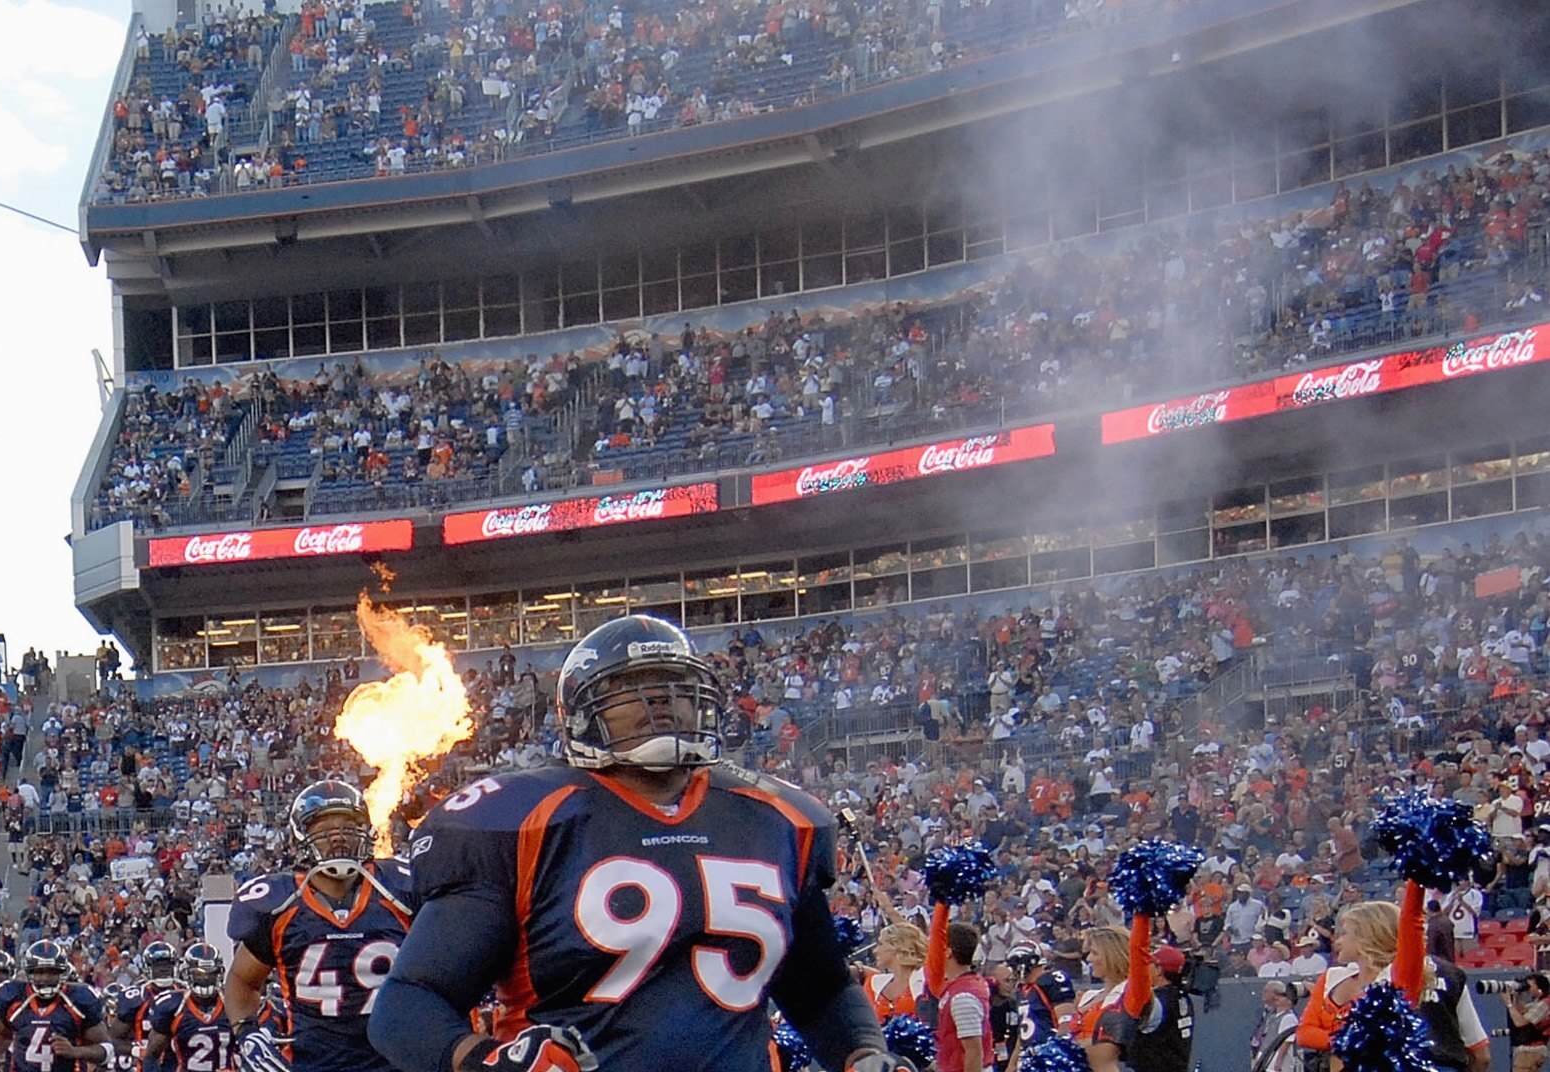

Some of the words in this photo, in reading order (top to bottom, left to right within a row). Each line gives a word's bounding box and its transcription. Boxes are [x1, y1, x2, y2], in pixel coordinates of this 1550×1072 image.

[184, 533, 252, 563] Coca-Cola
[294, 524, 364, 554] Coca-Cola
[1034, 785, 1044, 799] 7
[640, 834, 709, 847] BRONCOS
[1451, 902, 1465, 921] 6
[574, 855, 789, 1013] 95
[295, 940, 400, 1017] 49
[25, 1026, 54, 1072] 4
[186, 1031, 232, 1072] 21
